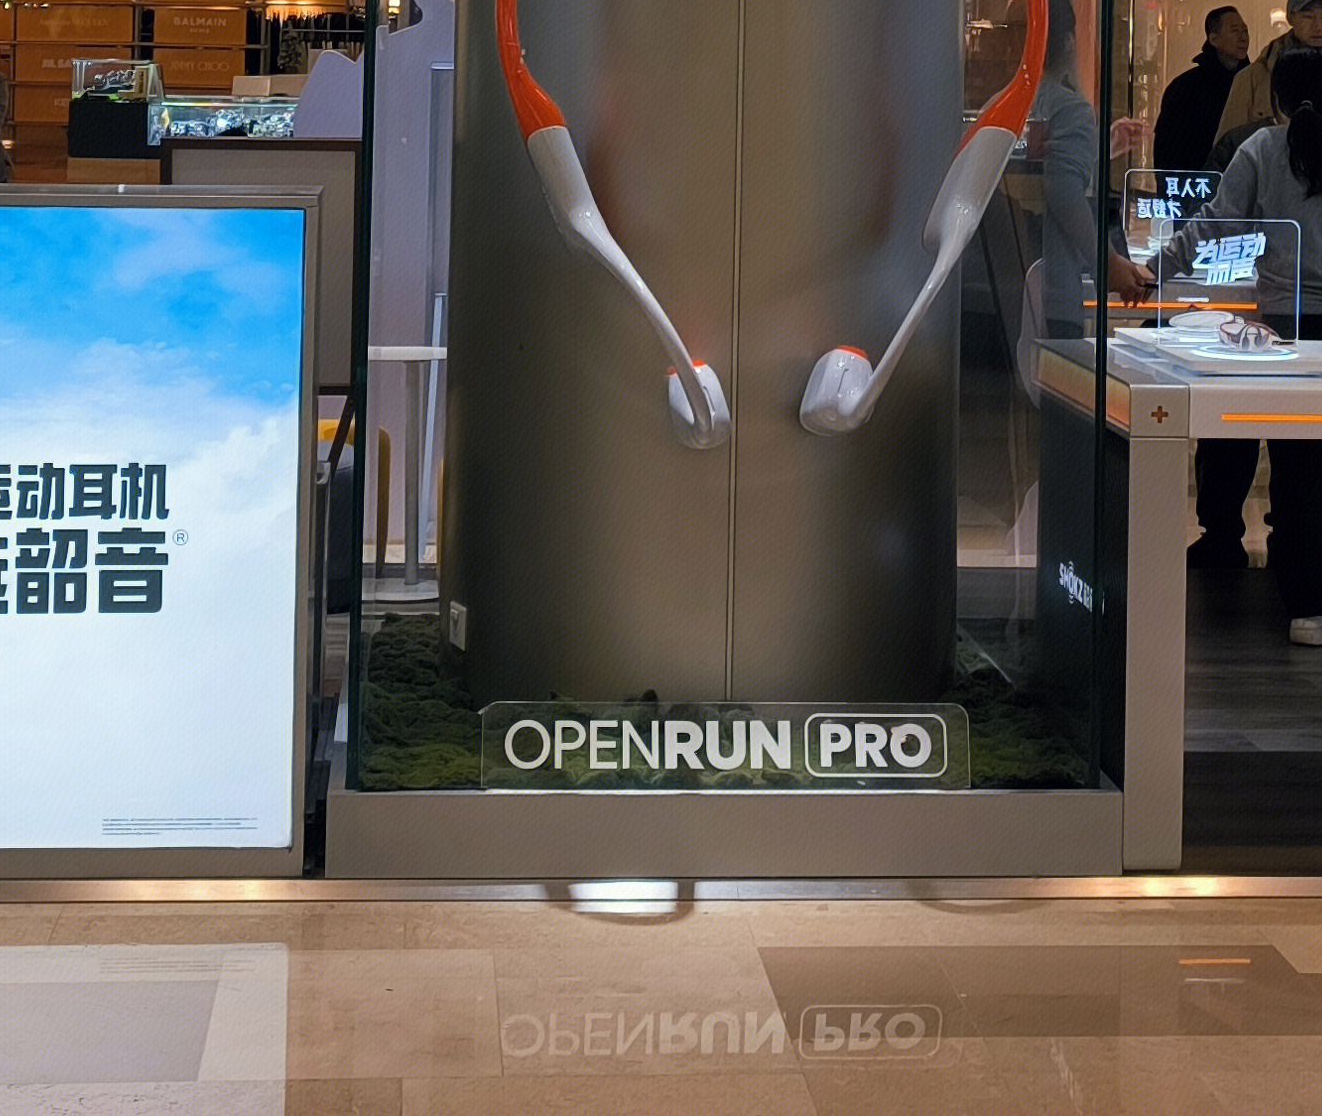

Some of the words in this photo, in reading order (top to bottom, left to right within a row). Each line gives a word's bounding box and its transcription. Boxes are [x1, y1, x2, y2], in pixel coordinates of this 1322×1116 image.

[173, 16, 227, 27] BALMAIN
[504, 718, 792, 771] OPENRUN
[819, 722, 933, 768] PRO
